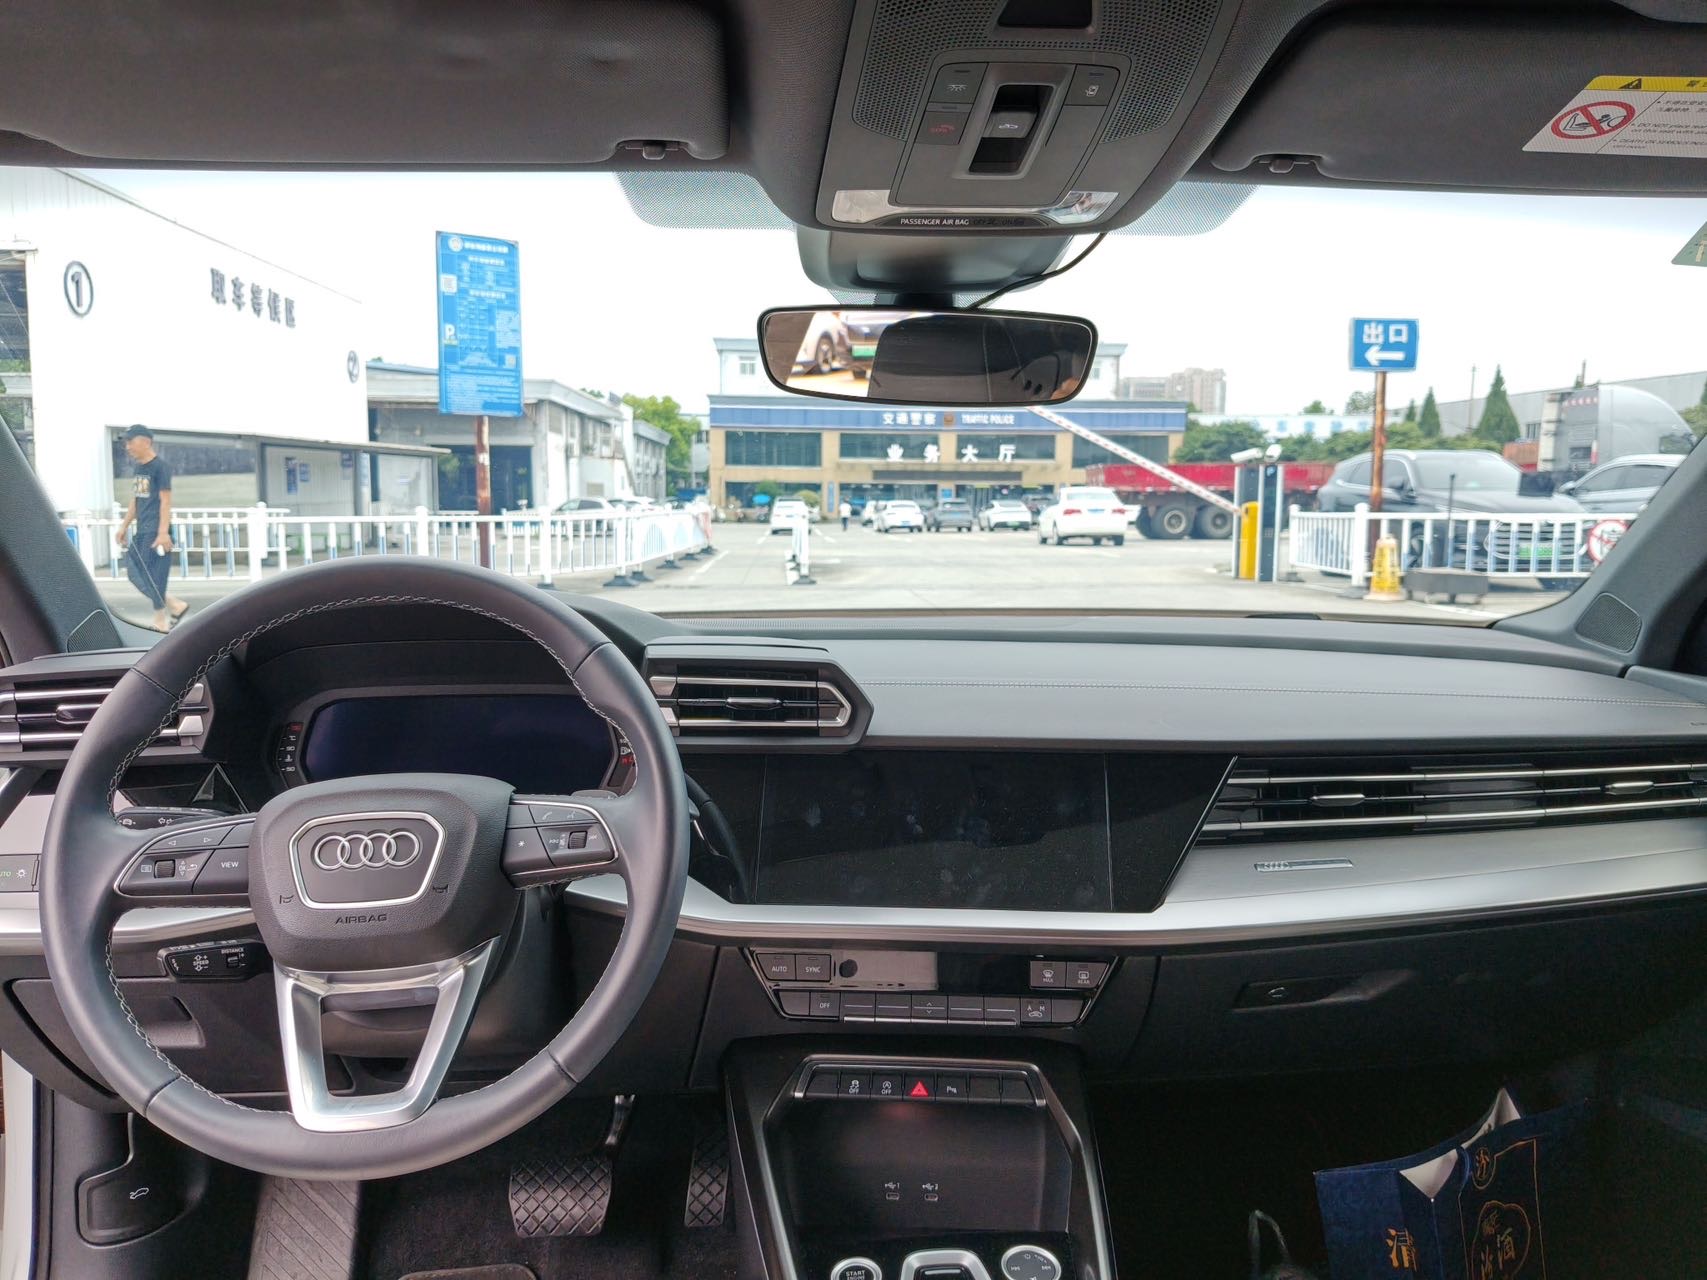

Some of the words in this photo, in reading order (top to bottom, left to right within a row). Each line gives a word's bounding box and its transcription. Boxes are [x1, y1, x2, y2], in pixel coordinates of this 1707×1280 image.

[942, 218, 953, 226] AIR
[1363, 321, 1408, 344] 出口
[882, 412, 937, 425] 交通警察
[990, 415, 1015, 424] POLICE
[886, 443, 1017, 462] 业务大厅
[178, 864, 187, 872] OK
[220, 861, 239, 869] VIEW
[335, 913, 388, 924] AIRBAG
[193, 959, 210, 967] SPEED
[845, 1269, 866, 1277] START
